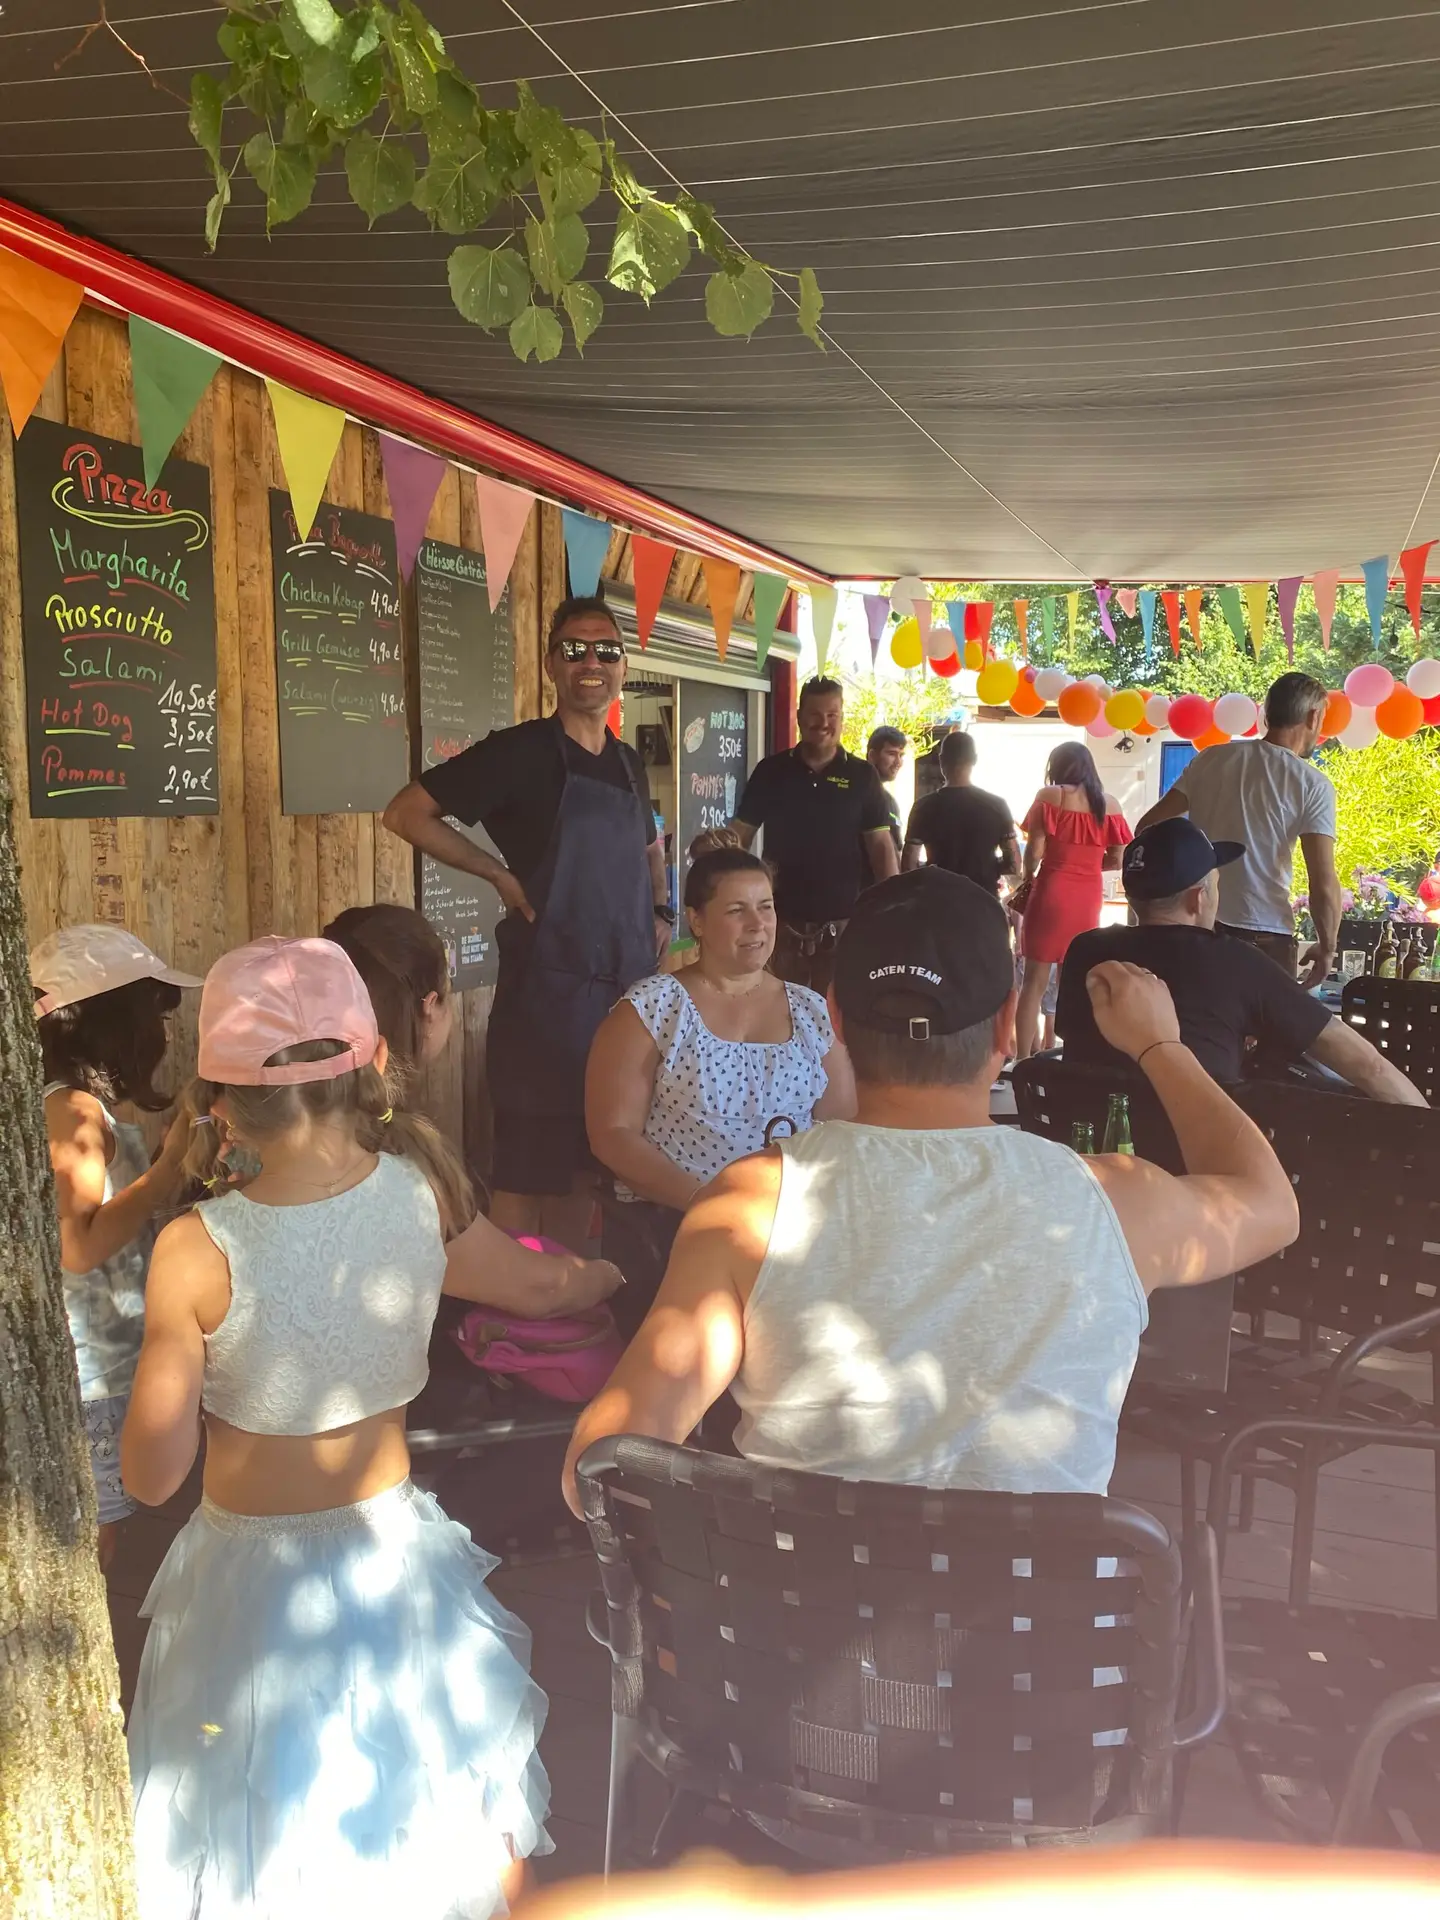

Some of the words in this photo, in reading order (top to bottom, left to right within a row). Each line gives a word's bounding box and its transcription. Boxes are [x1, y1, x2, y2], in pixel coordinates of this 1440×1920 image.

[63, 443, 173, 516] Pizza
[50, 527, 190, 601] Margharita
[281, 572, 330, 604] Chicken
[332, 582, 365, 619] Kebap
[371, 589, 400, 618] 4,90€
[46, 594, 173, 645] Prosciutto
[282, 629, 312, 652] Grill
[316, 633, 361, 658] Gemüse
[369, 638, 400, 664] 4,90€
[59, 647, 164, 684] Salami
[158, 679, 216, 713] 10,50€
[283, 680, 327, 702] Salami
[381, 692, 404, 717] 4,90€
[41, 699, 83, 727] Hot
[93, 702, 133, 742] Dog
[168, 717, 214, 747] 3,50€
[710, 711, 728, 729] HOT
[718, 735, 742, 763] 3,50€
[41, 745, 126, 784] Pommes
[164, 765, 212, 795] 2,90€
[691, 773, 724, 800] POMMES
[869, 965, 906, 980] CATEN
[909, 966, 943, 986] TEAM
